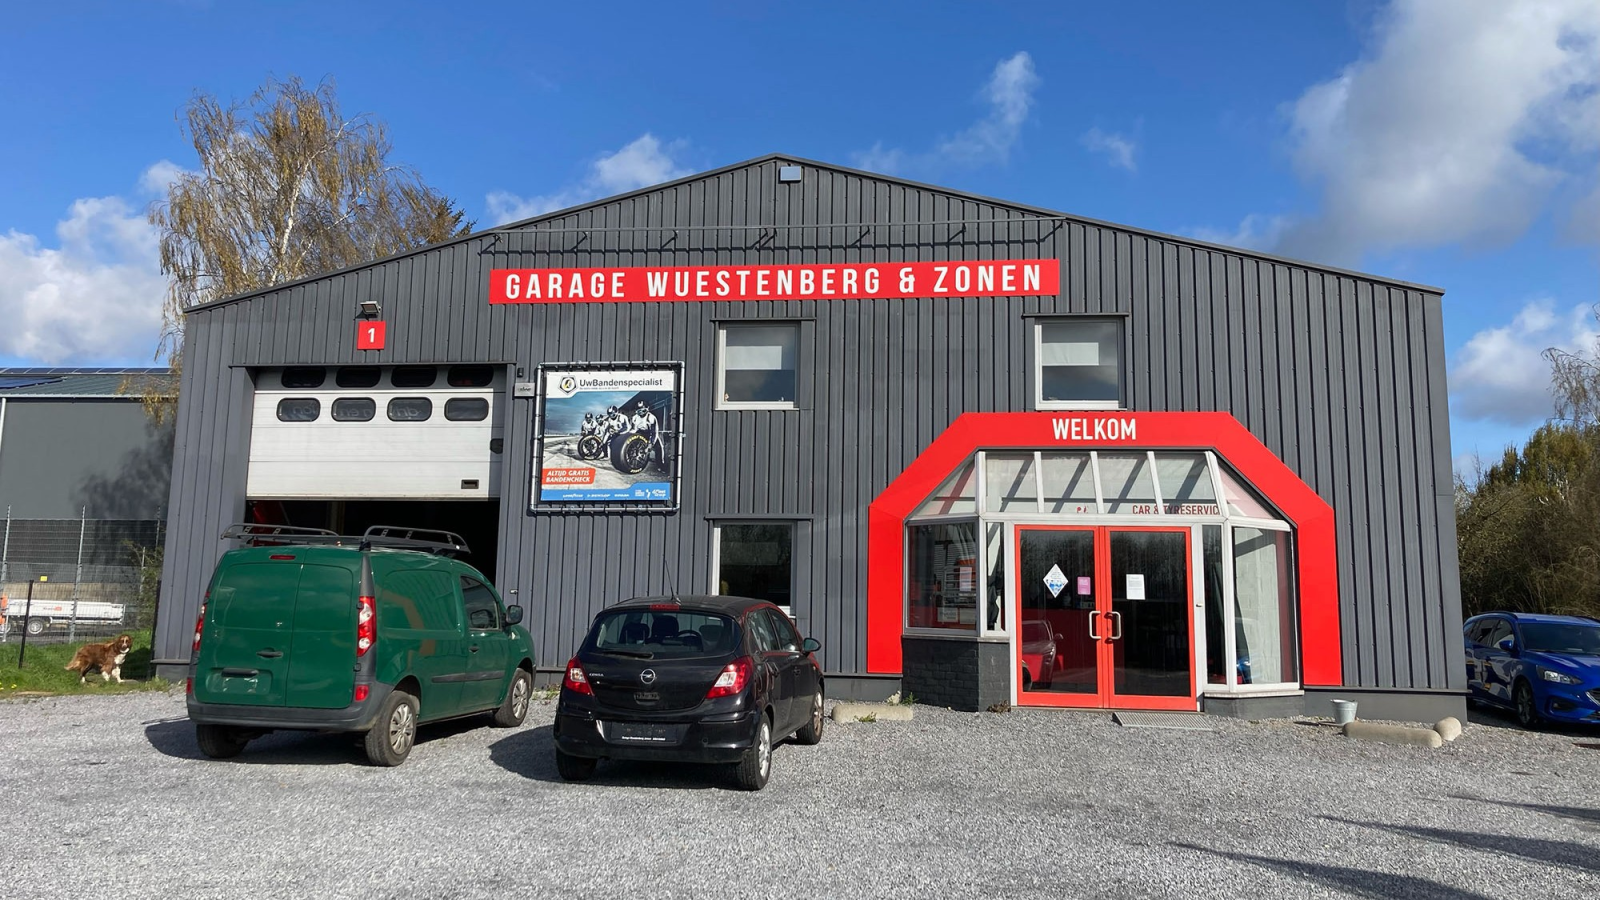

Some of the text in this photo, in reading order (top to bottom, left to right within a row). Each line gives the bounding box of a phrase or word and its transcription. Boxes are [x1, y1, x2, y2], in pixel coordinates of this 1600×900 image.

[505, 264, 1042, 300] GARAGE WUESTENBERG & ZONEN
[367, 327, 376, 343] 1
[579, 378, 663, 388] UwBandenspecialist
[1052, 418, 1137, 440] WELKOM
[1132, 505, 1151, 515] CAR
[1163, 505, 1221, 515] TYRESERVIC
